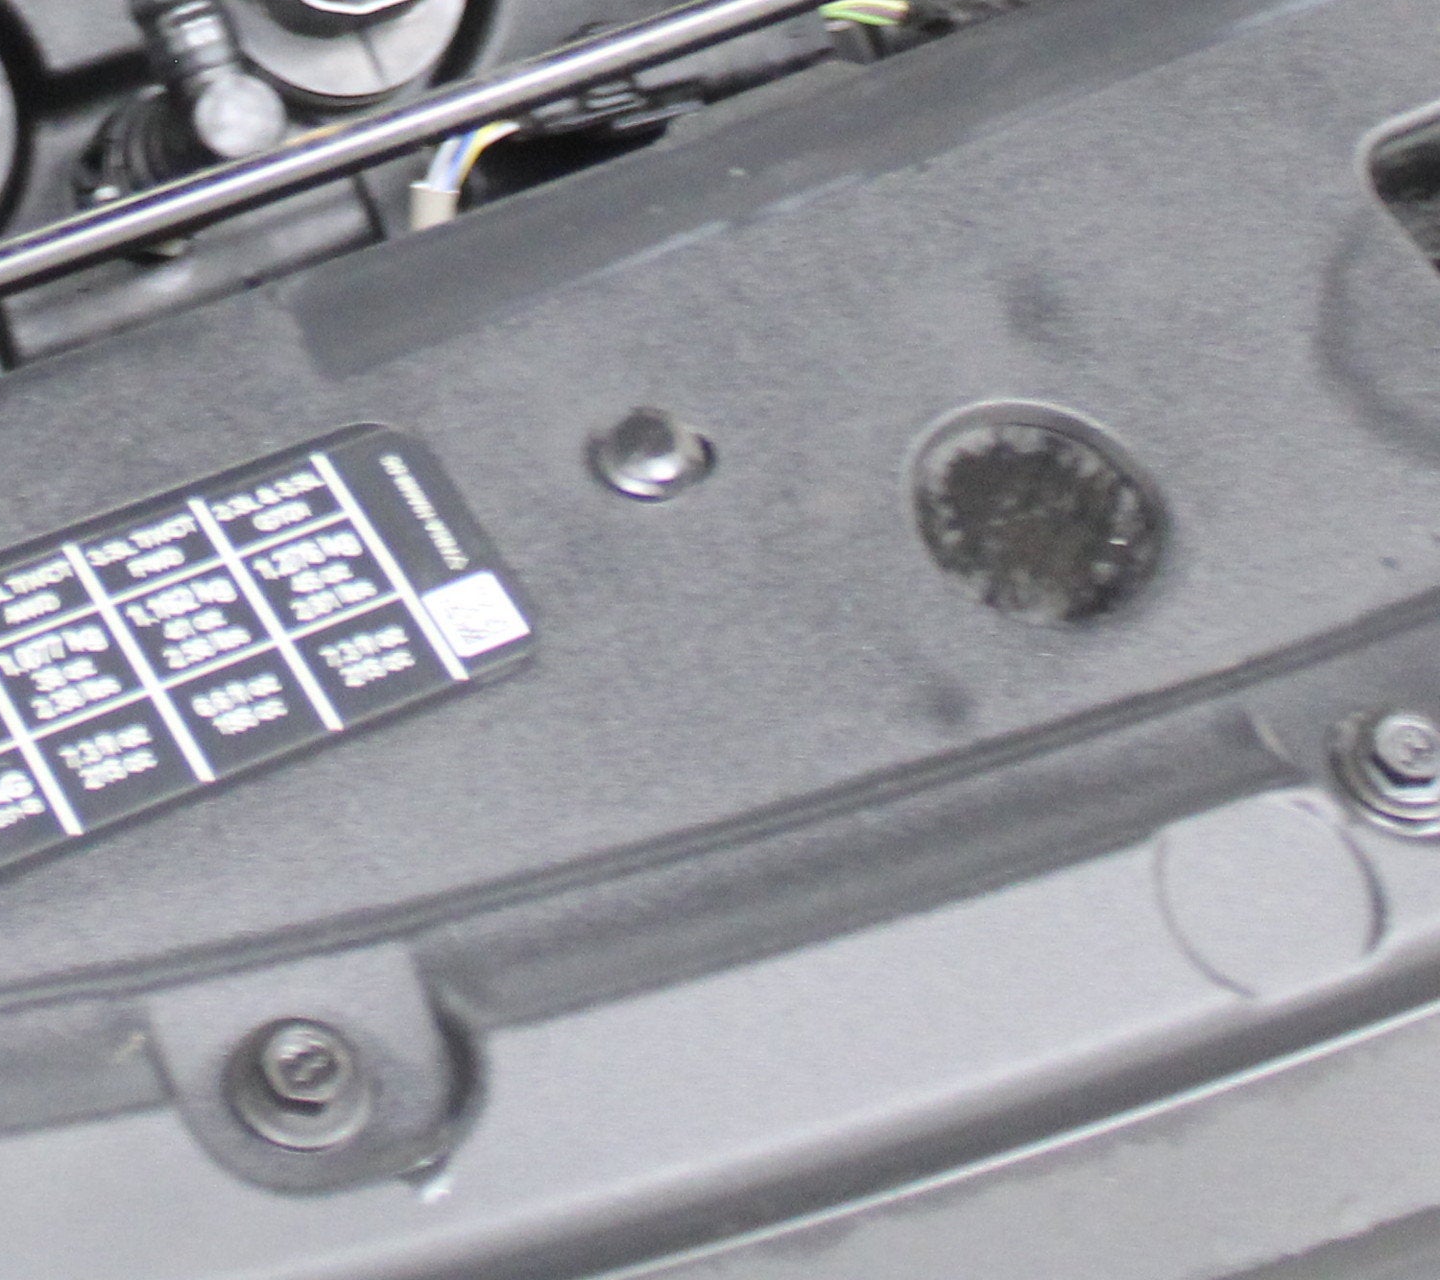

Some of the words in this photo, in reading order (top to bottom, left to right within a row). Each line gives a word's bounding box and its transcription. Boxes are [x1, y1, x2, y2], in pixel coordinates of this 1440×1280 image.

[315, 531, 363, 567] kg
[189, 577, 238, 613] kg
[60, 625, 109, 663] kg
